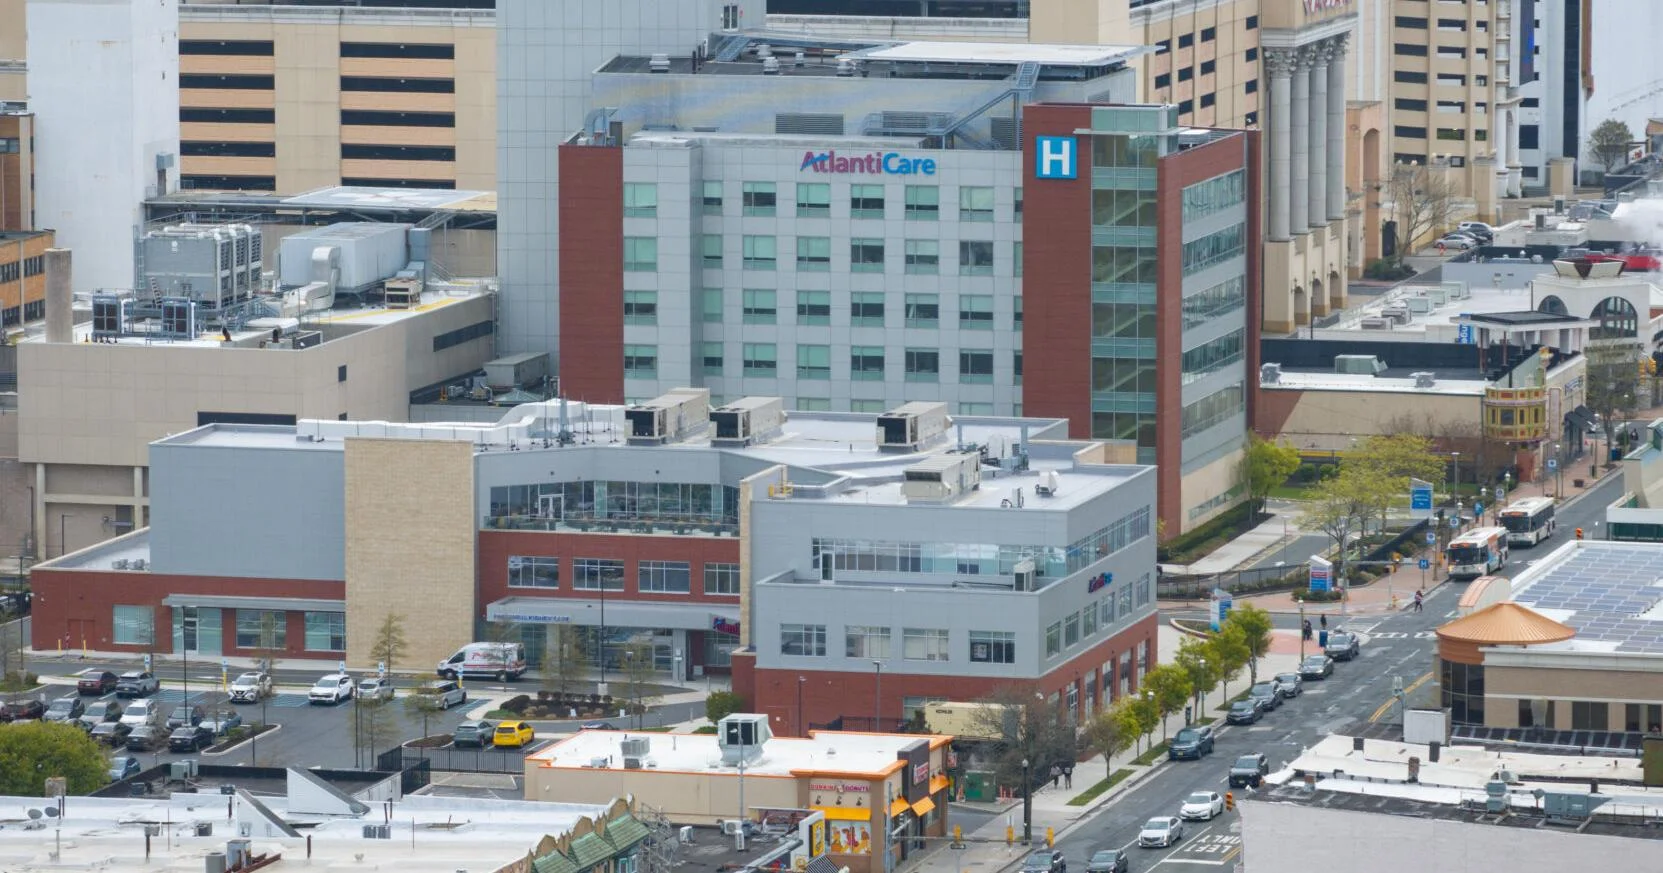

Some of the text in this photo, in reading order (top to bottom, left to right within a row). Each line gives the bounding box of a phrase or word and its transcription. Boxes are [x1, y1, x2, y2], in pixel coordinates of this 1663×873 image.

[799, 151, 936, 175] AtlantiCare
[1042, 140, 1070, 176] H
[1184, 844, 1232, 854] LEFT
